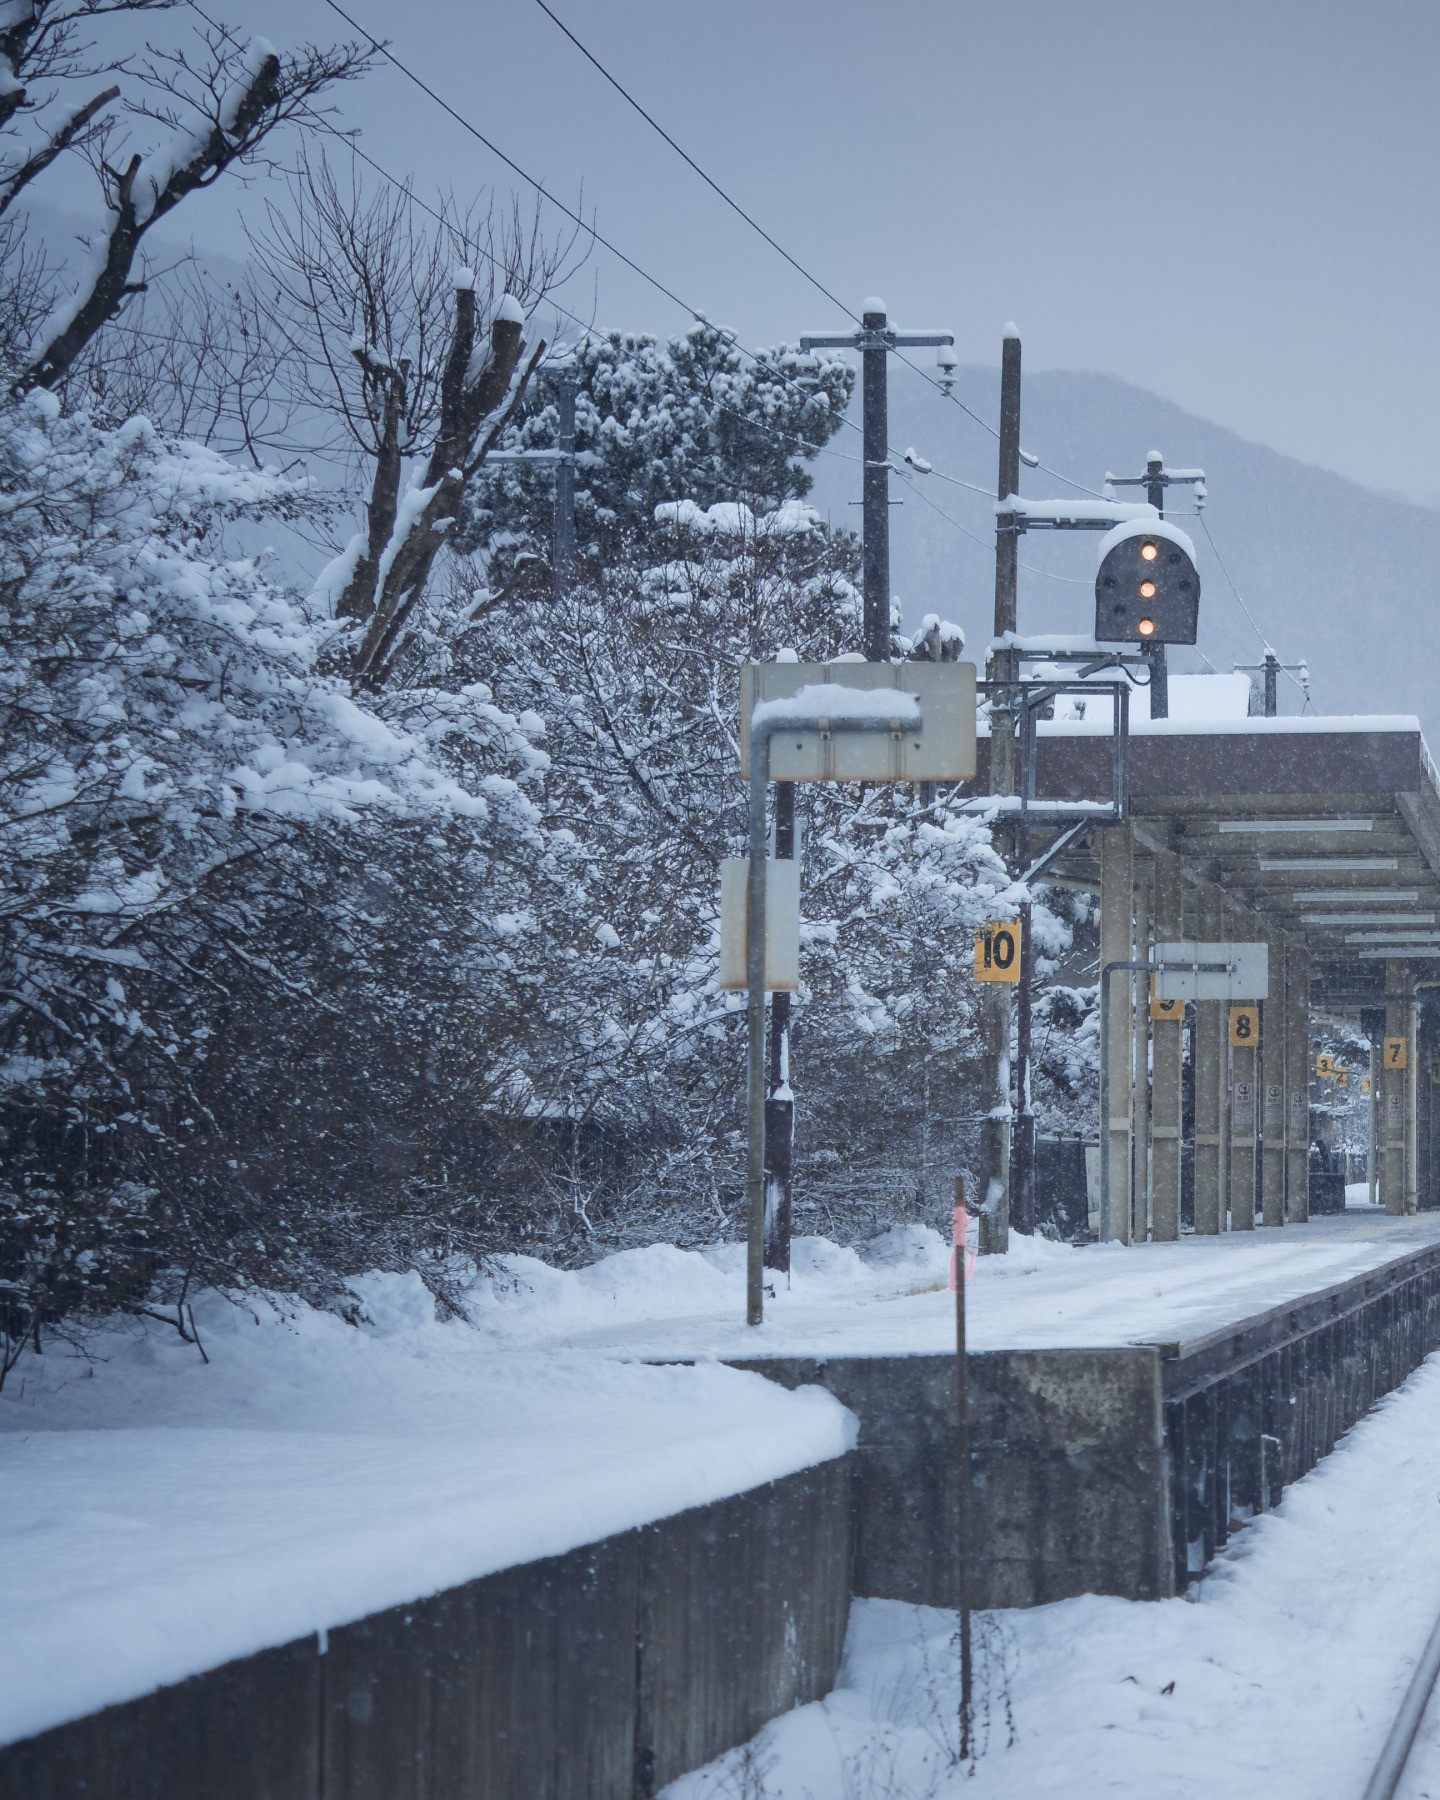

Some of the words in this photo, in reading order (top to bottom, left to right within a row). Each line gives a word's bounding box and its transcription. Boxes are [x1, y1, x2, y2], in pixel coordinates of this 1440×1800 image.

[982, 930, 1014, 969] 10
[1236, 1014, 1251, 1038] 8
[1389, 1043, 1401, 1062] 7
[1320, 1059, 1328, 1072] 3
